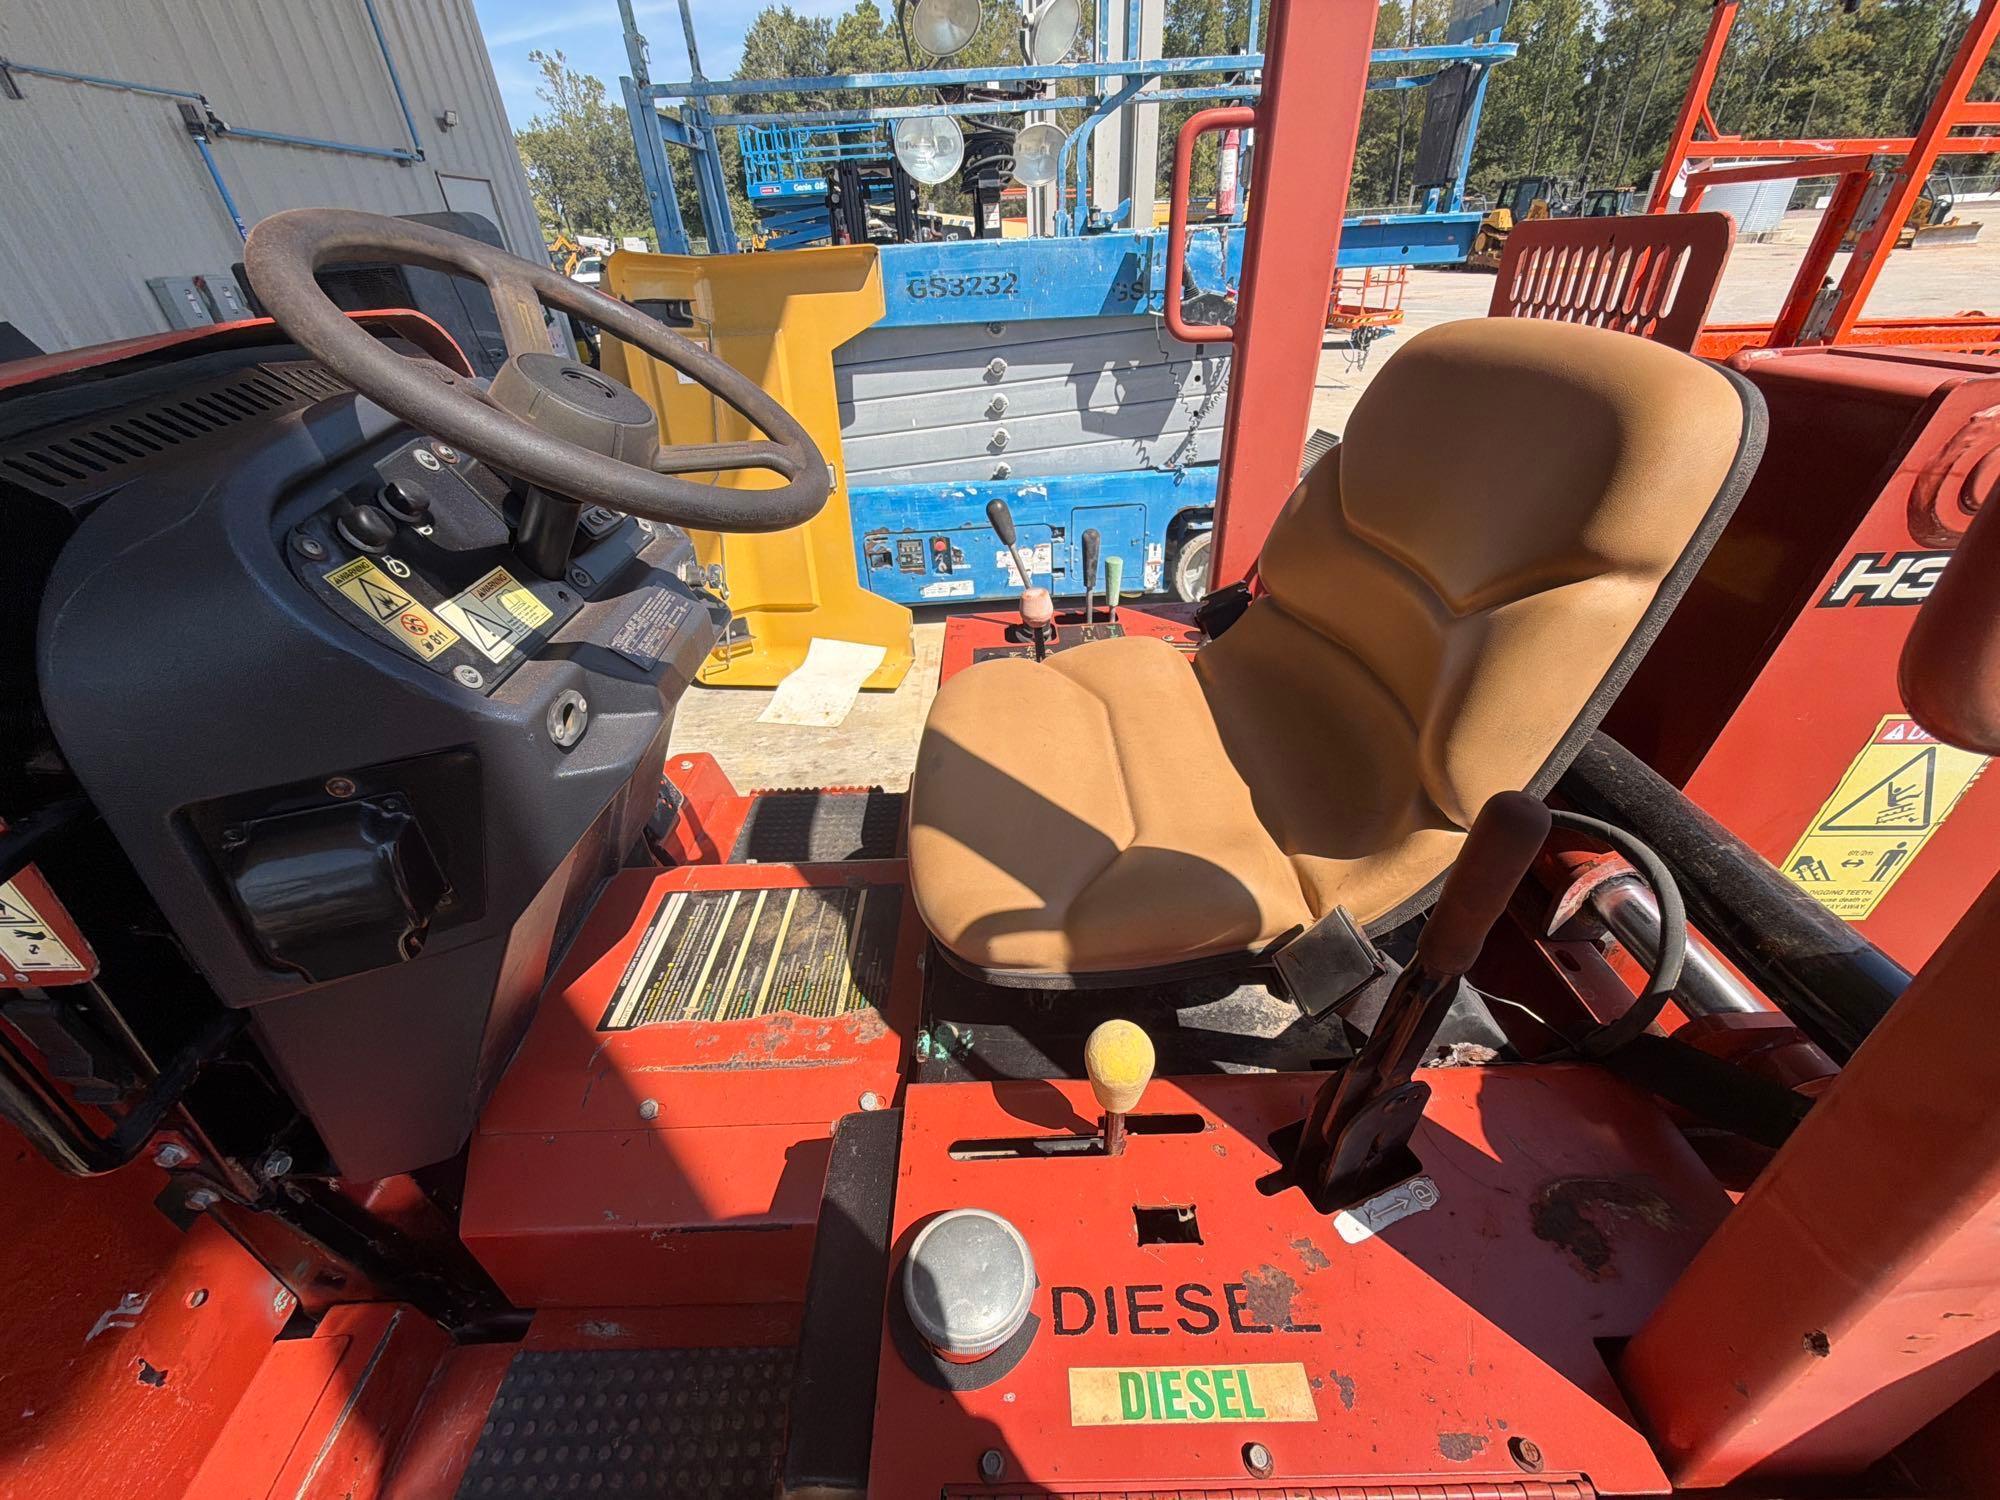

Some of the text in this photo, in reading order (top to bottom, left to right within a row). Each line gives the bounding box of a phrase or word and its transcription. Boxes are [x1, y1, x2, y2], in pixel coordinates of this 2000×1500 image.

[793, 183, 812, 193] Genie
[907, 272, 1019, 299] GS3232
[339, 561, 370, 582] WARNING
[482, 573, 508, 596] WARNING
[429, 629, 449, 646] 811
[1119, 1369, 1266, 1421] DIESEL
